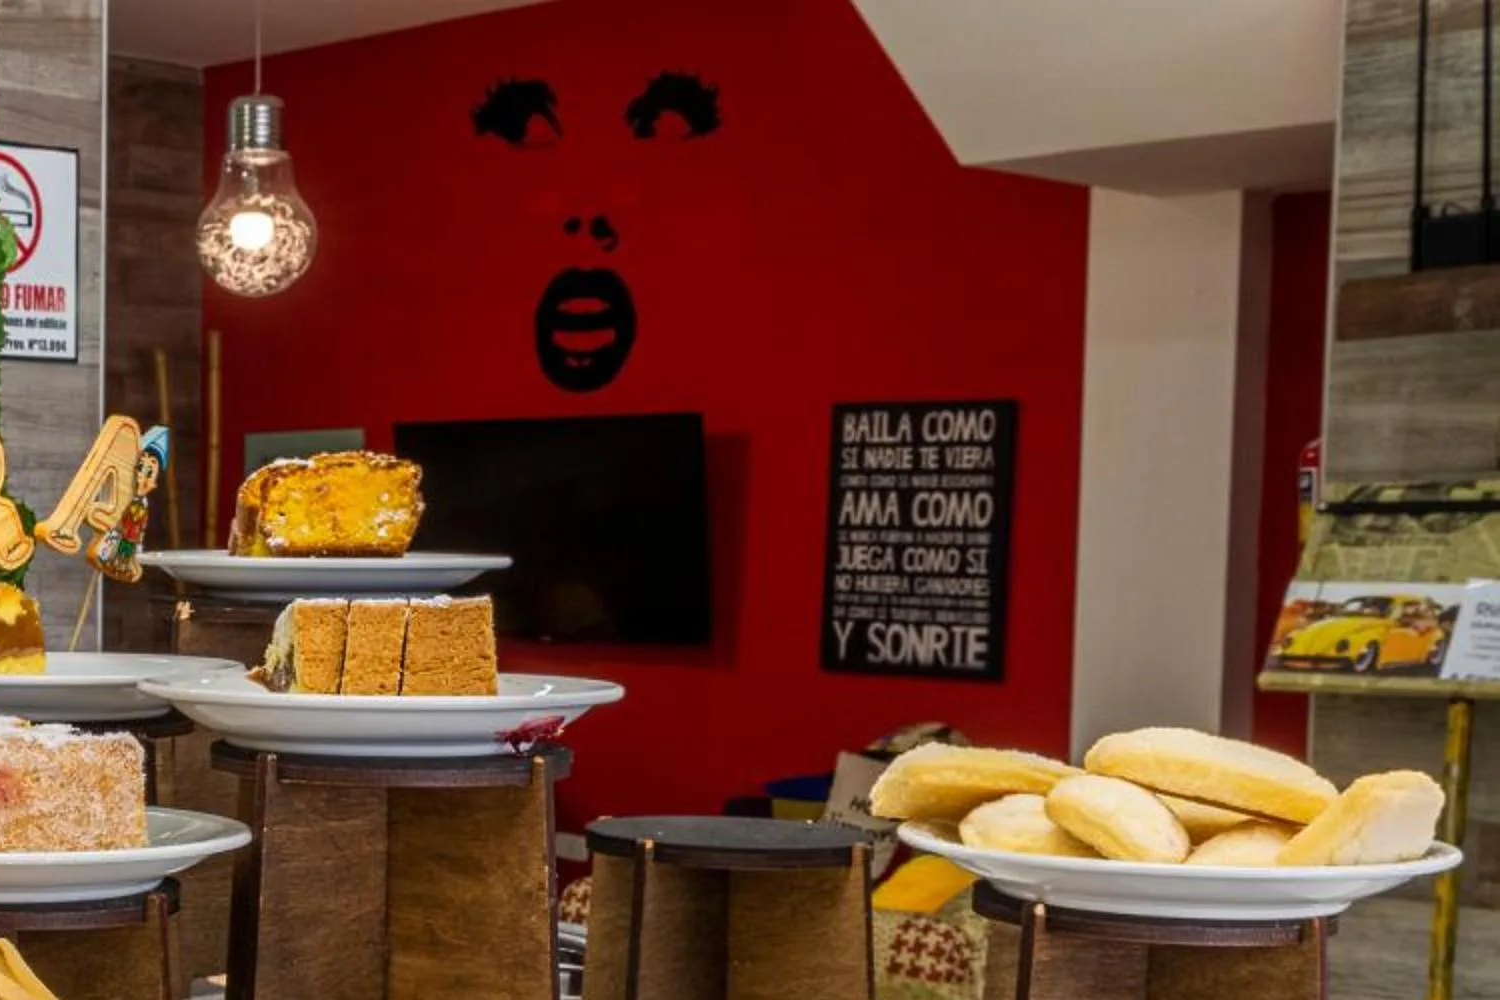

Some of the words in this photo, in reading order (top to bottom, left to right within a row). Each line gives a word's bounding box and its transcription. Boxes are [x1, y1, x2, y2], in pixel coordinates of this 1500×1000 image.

[15, 284, 66, 312] FUMAR
[842, 411, 913, 443] BAILA
[921, 409, 996, 443] COMO
[840, 447, 858, 469] SI
[863, 447, 914, 469] NADIE
[920, 447, 939, 469] TE
[945, 446, 995, 470] VIERA
[838, 490, 901, 527] AMA
[911, 491, 994, 528] COMO
[835, 545, 896, 572] JUEGA
[902, 546, 961, 574] COMO
[966, 547, 989, 574] SI
[835, 574, 852, 591] NO
[832, 620, 854, 660] Y
